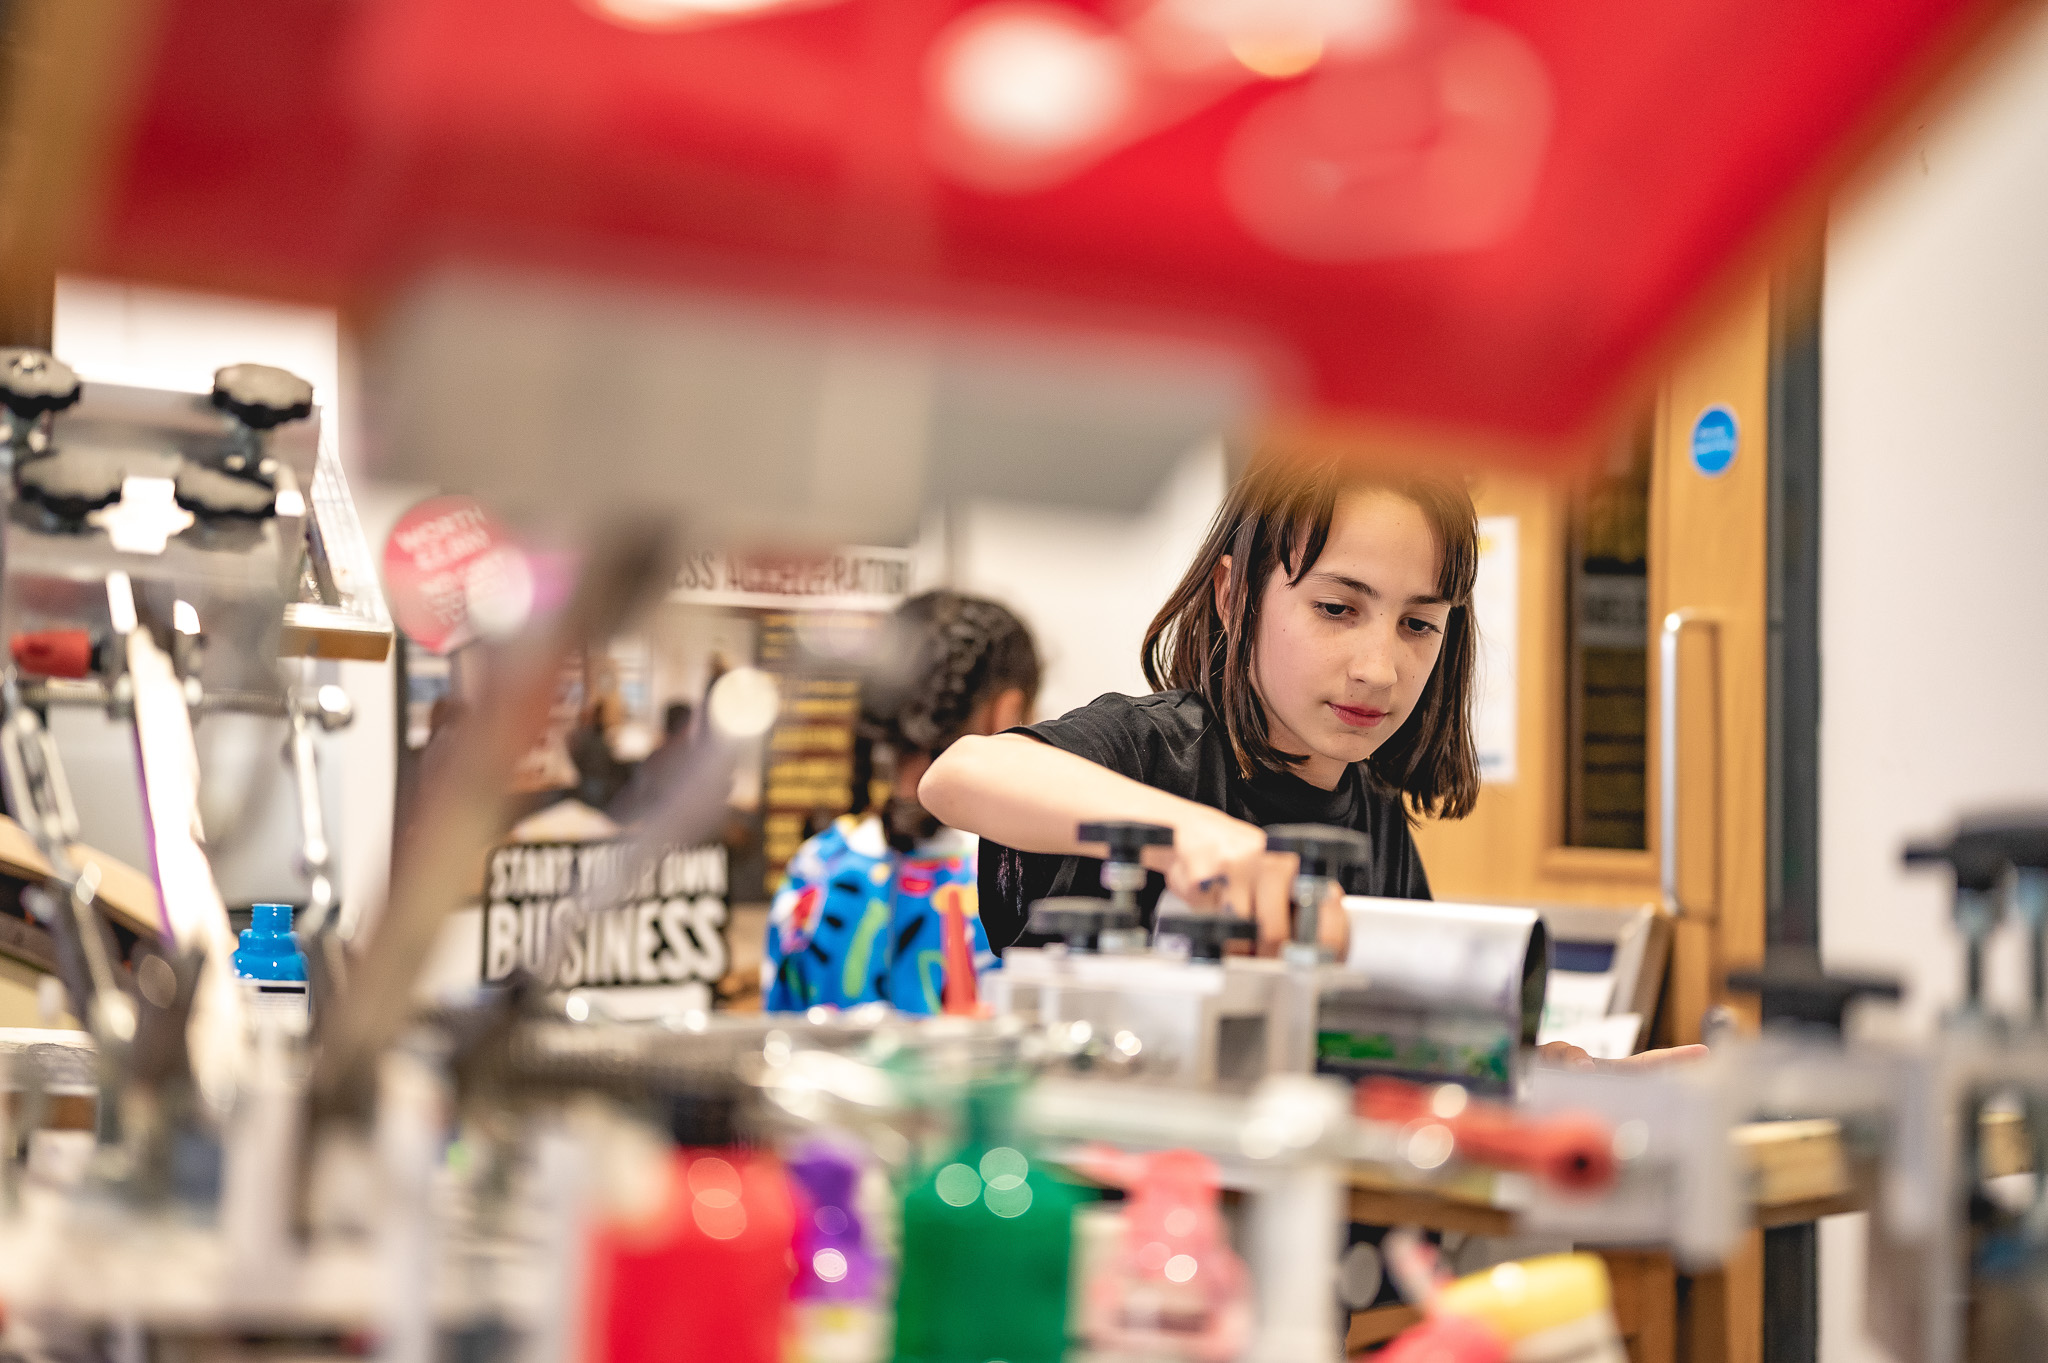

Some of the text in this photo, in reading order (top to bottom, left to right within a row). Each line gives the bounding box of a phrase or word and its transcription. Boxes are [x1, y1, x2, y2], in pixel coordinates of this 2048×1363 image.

[490, 845, 574, 900] START
[658, 842, 727, 899] OWN
[485, 895, 728, 987] BUSINESS
